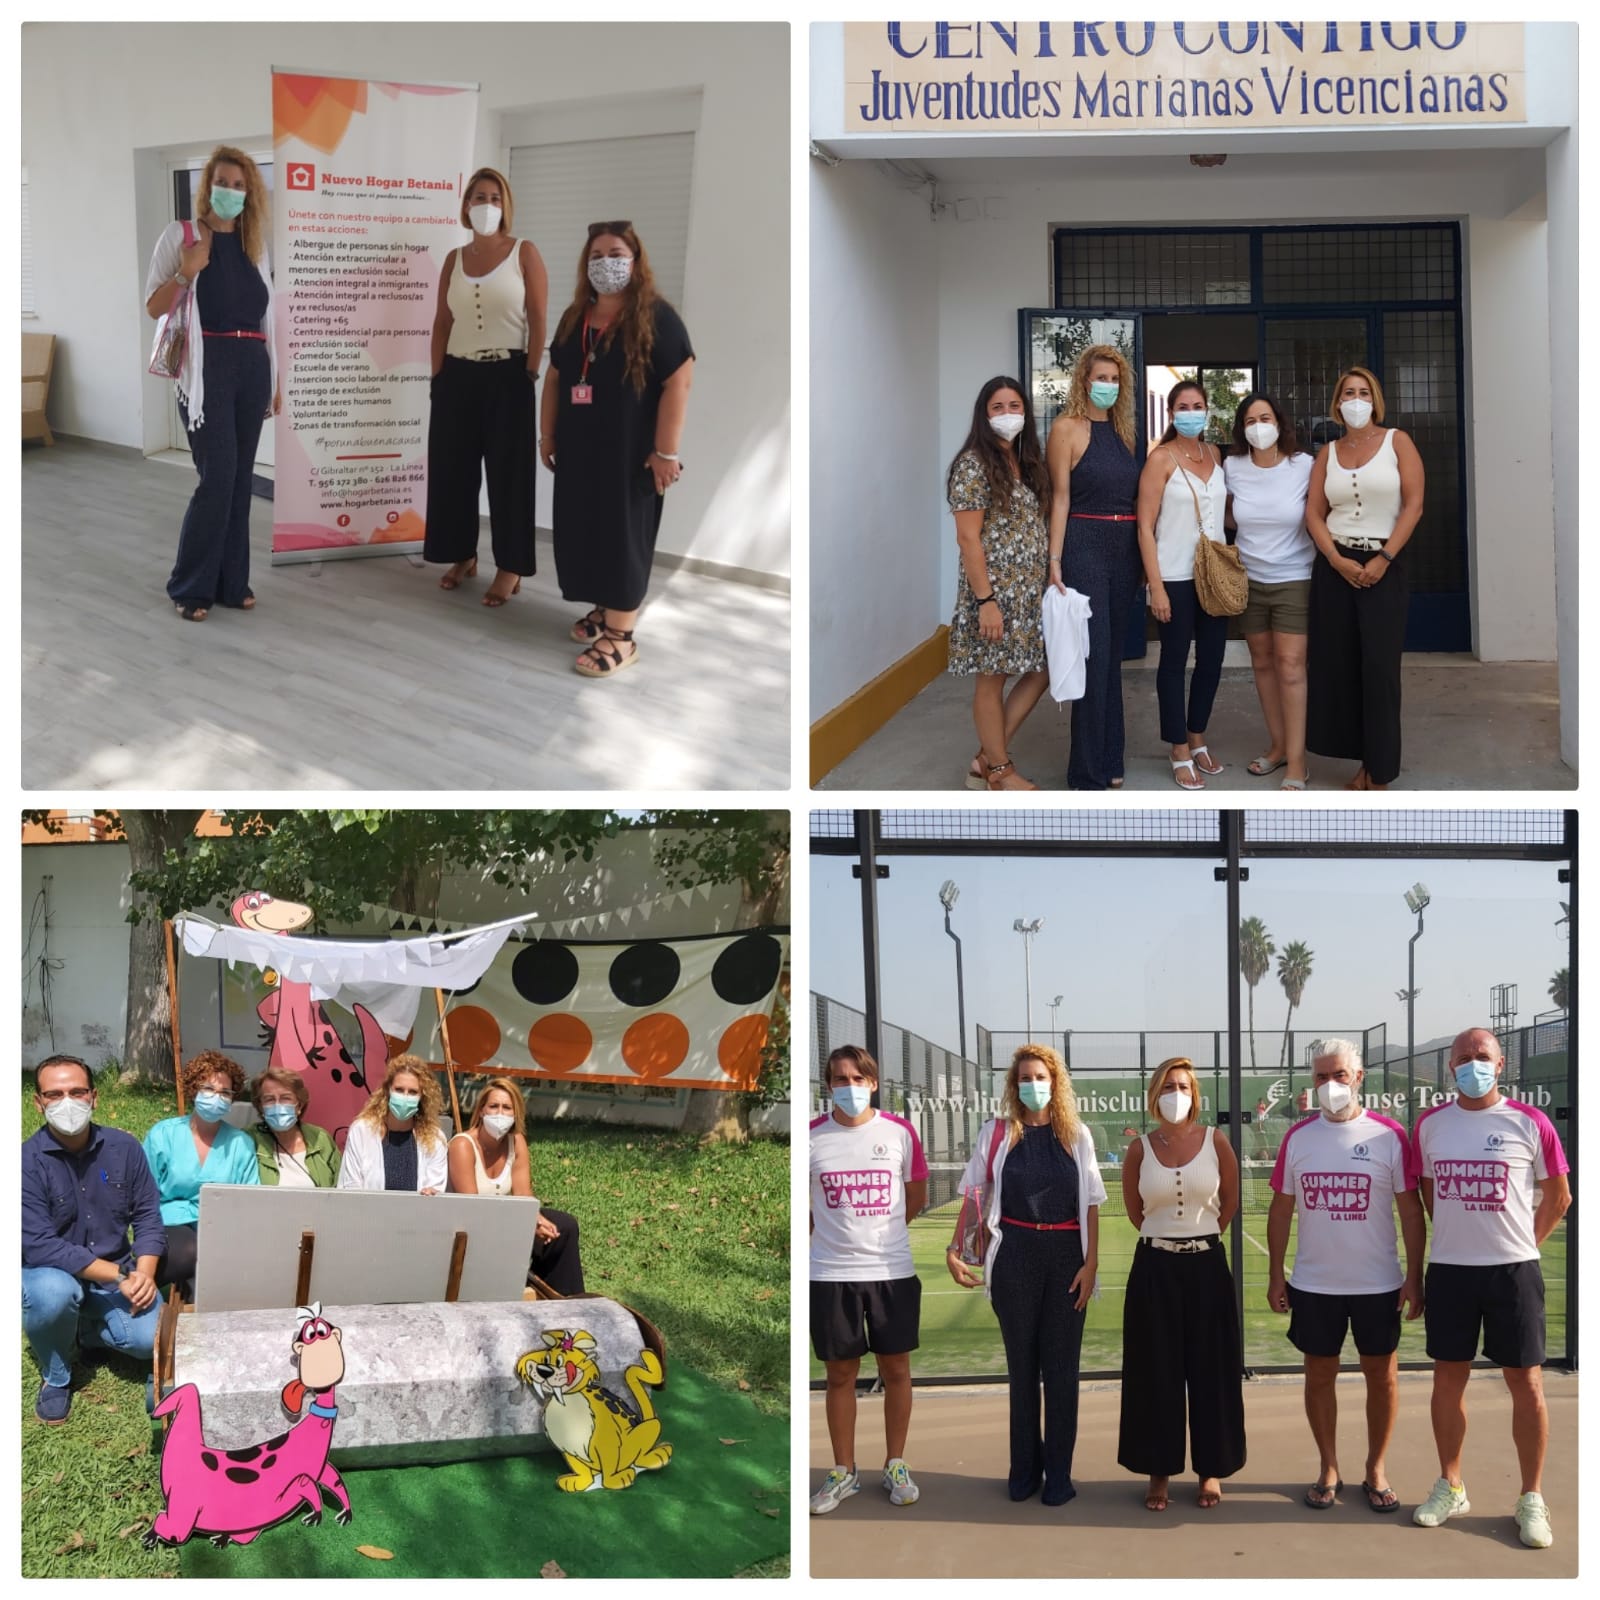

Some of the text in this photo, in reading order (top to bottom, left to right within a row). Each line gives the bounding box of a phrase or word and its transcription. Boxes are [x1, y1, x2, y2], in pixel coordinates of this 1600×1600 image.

[860, 65, 1508, 121] Juventudes Marianas Vicencianas
[321, 173, 453, 191] Nuevo Hogar Betania
[288, 209, 317, 220] Únete
[319, 213, 335, 221] con
[337, 213, 371, 222] nuestro
[373, 213, 403, 224] equipo
[411, 215, 457, 225] cambiarlas
[302, 225, 325, 233] estas
[327, 225, 368, 234] acciones:
[293, 239, 429, 253] Albergue de personas sin hogar
[293, 252, 334, 262] Atención
[336, 253, 399, 264] extracurricular
[288, 266, 327, 275] menores
[342, 266, 382, 275] exclusión
[384, 266, 409, 276] social
[293, 279, 334, 287] Atencion
[336, 279, 369, 290] integral
[378, 280, 429, 291] inmigrantes
[293, 291, 334, 300] Atención
[336, 292, 369, 302] integral
[378, 292, 424, 301] reclusos/as
[288, 305, 294, 313] y
[308, 303, 356, 313] reclusos/as
[293, 316, 349, 326] Catering +65
[293, 328, 430, 337] Centro residencial para personas
[301, 340, 342, 348] exclusión
[344, 340, 368, 348] social
[293, 352, 360, 360] Comedor Social
[294, 364, 370, 372] Escuela de verano
[293, 375, 332, 384] Insercion
[334, 375, 356, 383] socio
[358, 374, 387, 383] laboral
[389, 374, 399, 382] de
[301, 388, 328, 397] riesgo
[330, 387, 341, 395] de
[342, 386, 381, 395] exclusión
[318, 398, 328, 406] de
[353, 397, 391, 405] humanos
[293, 410, 348, 419] Voluntariado
[293, 418, 421, 430] Zonas de transformación social
[315, 436, 421, 450] #porunabuenacausa
[310, 467, 320, 476] C/
[321, 465, 357, 475] Gibraltar
[370, 466, 384, 474] 152
[390, 464, 401, 472] La
[308, 479, 317, 488] T.
[318, 480, 334, 488] 956
[336, 479, 350, 487] 172
[352, 477, 368, 486] 380
[375, 475, 390, 484] 626
[392, 474, 407, 482] 826
[409, 473, 424, 482] 866
[321, 486, 412, 498] info@hogarbetania.es
[320, 497, 412, 510] www.hogarbetania.es
[1434, 1162, 1507, 1179] SUMMER
[822, 1172, 890, 1188] SUMMER
[1302, 1173, 1369, 1191] SUMMER
[1437, 1180, 1506, 1201] CAMPS
[827, 1188, 891, 1206] CAMPS
[1305, 1191, 1367, 1209] CAMPS
[856, 1209, 891, 1217] LA LINEA
[1465, 1202, 1506, 1212] LA LINEA
[1331, 1212, 1367, 1221] LA LINEA
